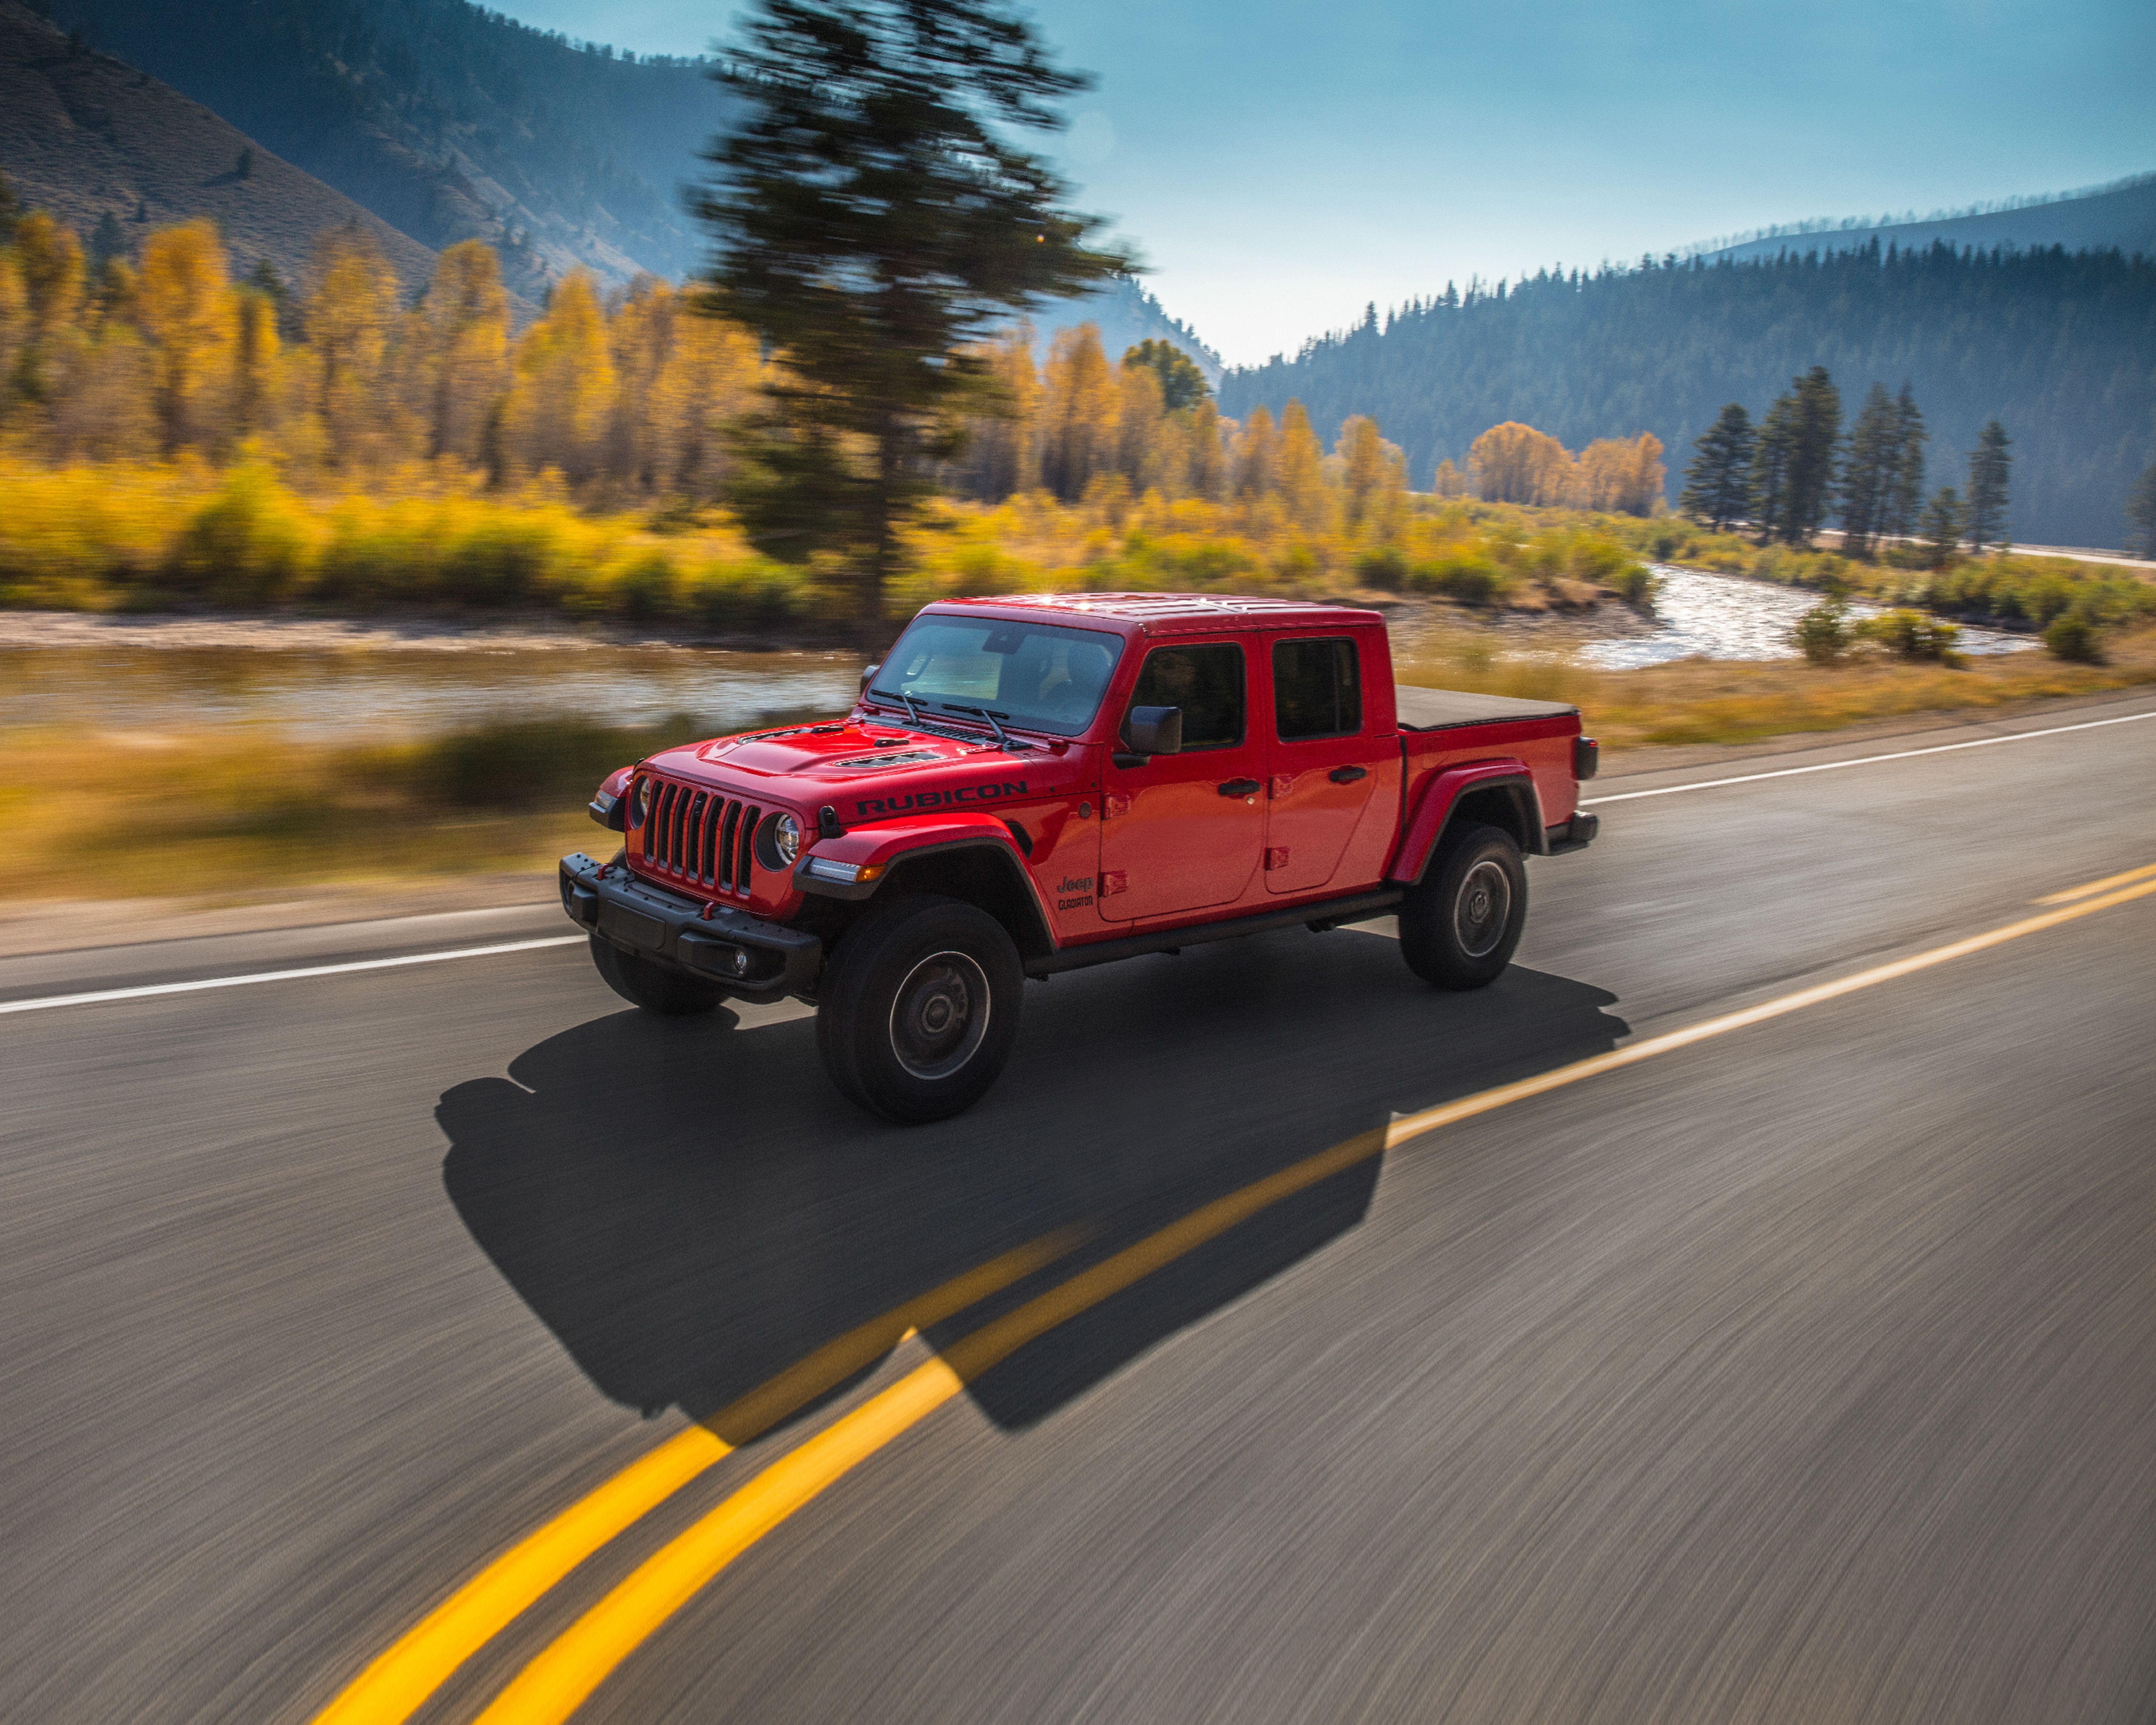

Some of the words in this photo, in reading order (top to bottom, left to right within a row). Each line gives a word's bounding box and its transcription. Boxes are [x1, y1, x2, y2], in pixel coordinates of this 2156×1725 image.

[857, 780, 1028, 815] RUBICON
[1057, 877, 1094, 893] Jeep
[1058, 895, 1093, 910] GLADIATOR
